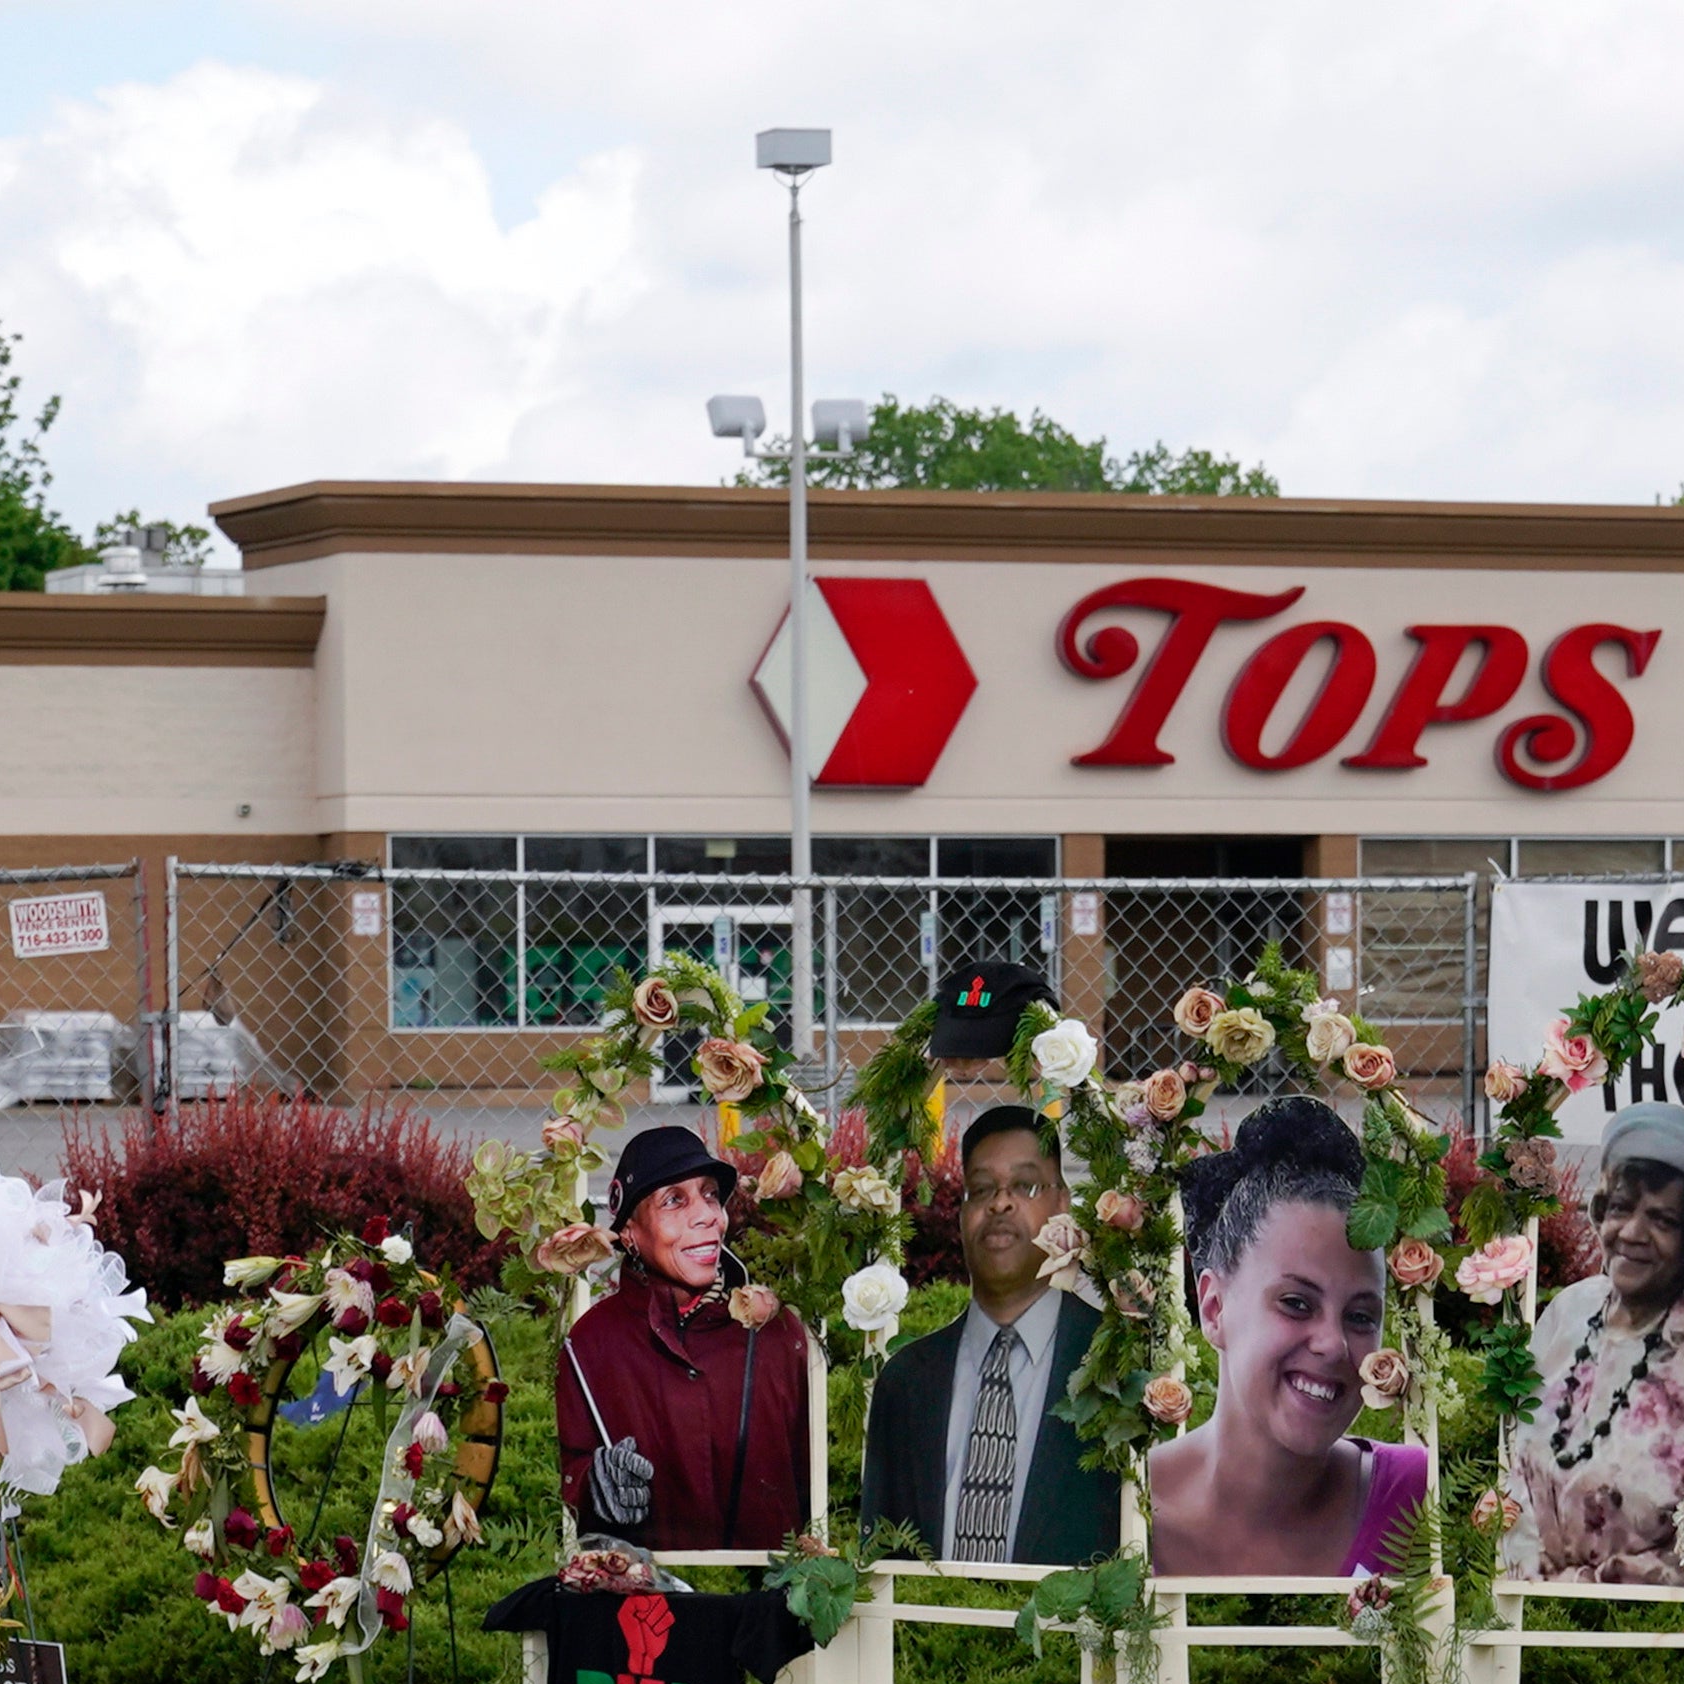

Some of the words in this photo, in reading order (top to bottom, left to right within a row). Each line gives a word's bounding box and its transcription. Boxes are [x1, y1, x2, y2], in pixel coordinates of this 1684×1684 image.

[15, 897, 100, 923] WOODSMITH
[18, 920, 53, 933] FENCE
[56, 917, 100, 928] RENTAL
